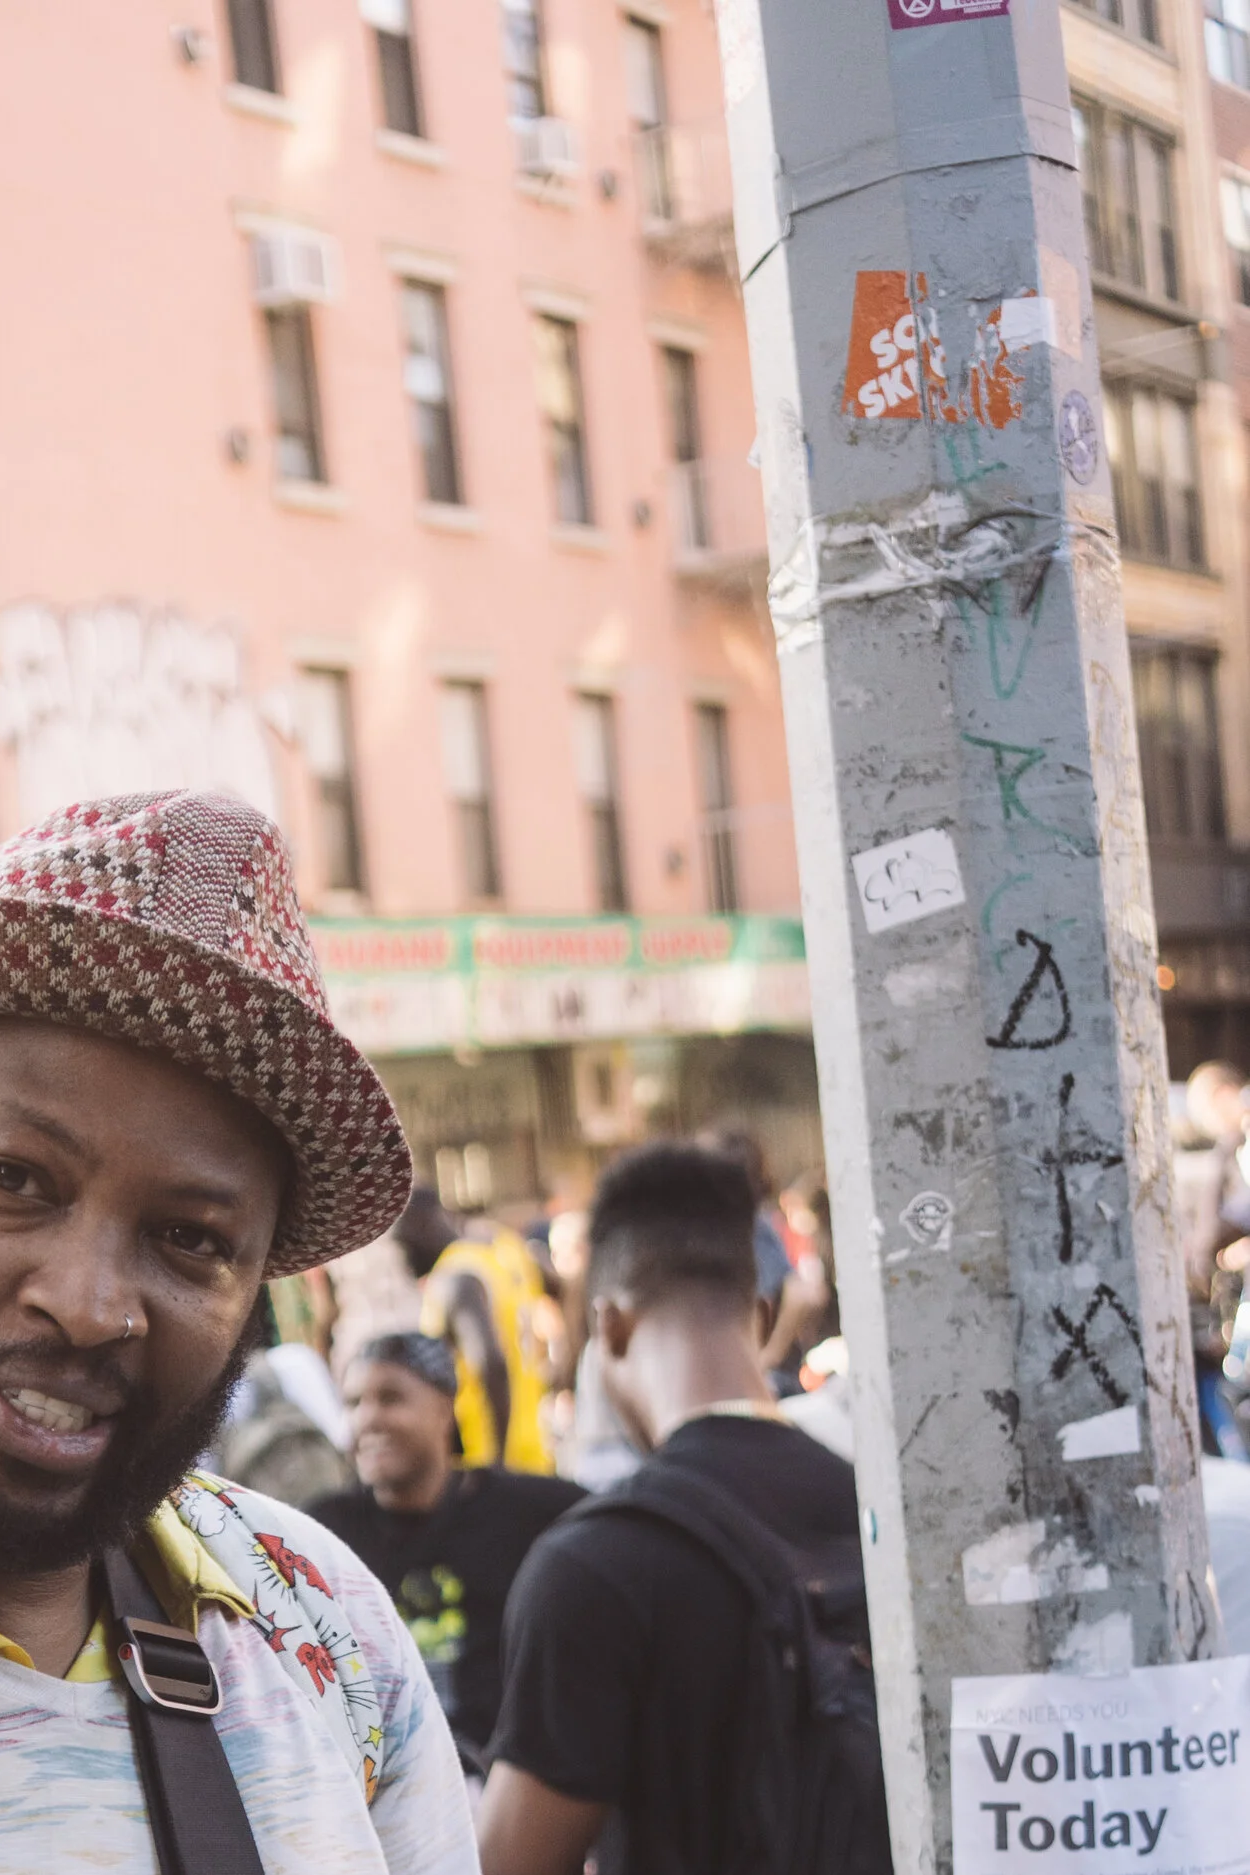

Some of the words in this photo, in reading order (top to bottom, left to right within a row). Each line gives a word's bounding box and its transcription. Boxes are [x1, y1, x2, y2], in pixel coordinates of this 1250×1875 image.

[1019, 1704, 1085, 1724] NEEDS
[1089, 1701, 1129, 1720] YOU
[978, 1726, 1240, 1784] Volunteer
[980, 1800, 1168, 1856] Today
